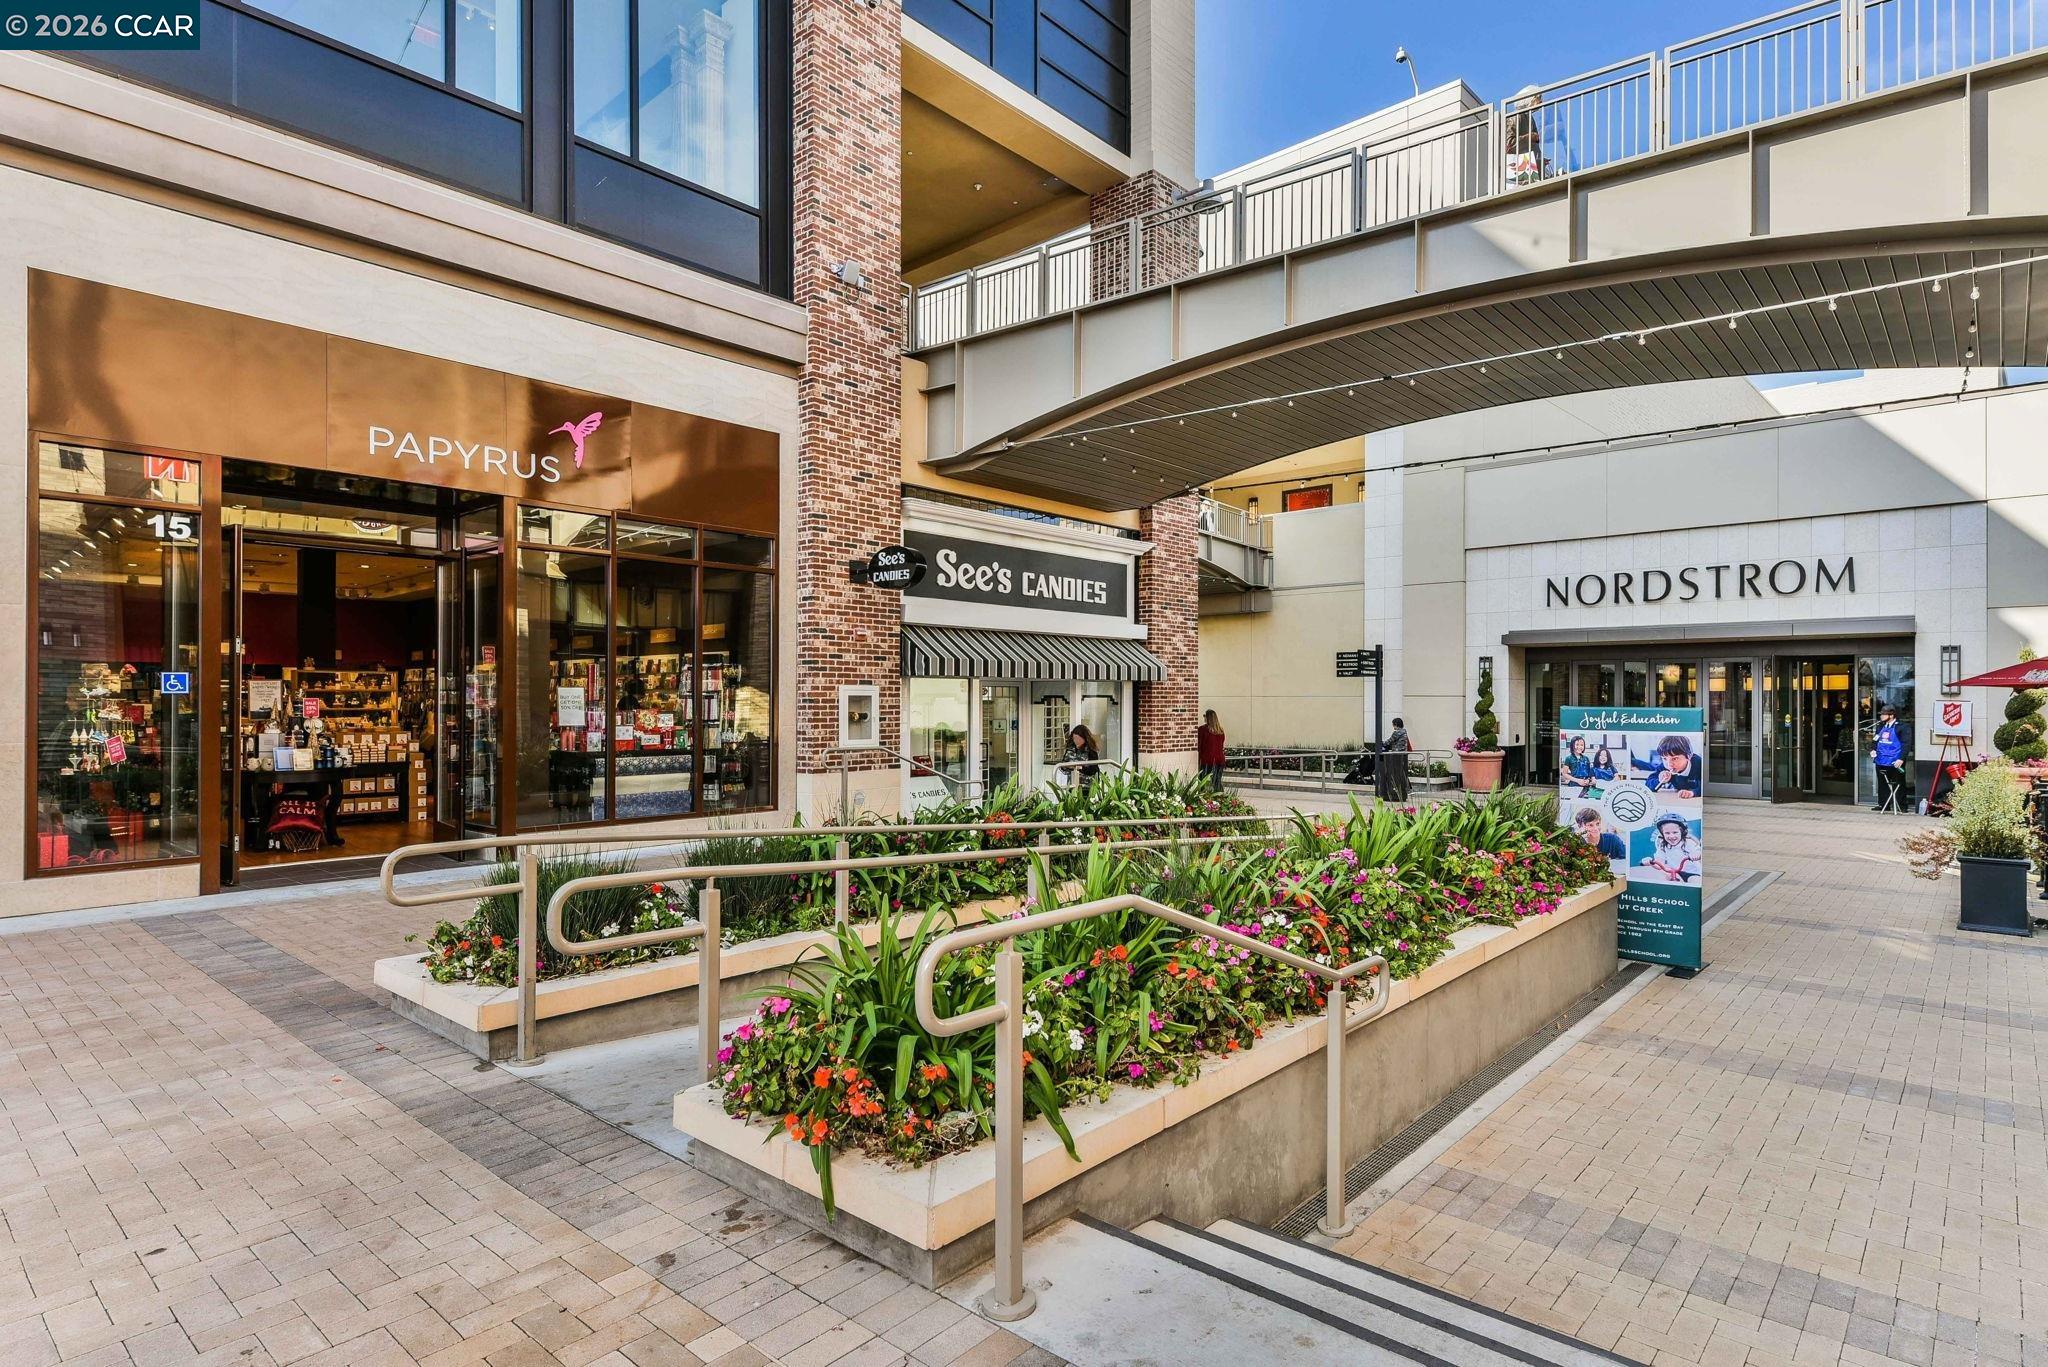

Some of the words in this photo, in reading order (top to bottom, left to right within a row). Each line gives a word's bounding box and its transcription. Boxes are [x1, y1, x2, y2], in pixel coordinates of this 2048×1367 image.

[368, 425, 561, 483] PAPYRUS
[147, 514, 191, 540] 15
[878, 551, 906, 566] See's
[873, 569, 910, 583] CANDIES
[935, 548, 1012, 594] See's
[1021, 571, 1107, 605] CANDIES
[1546, 556, 1856, 607] NORDSTROM
[1580, 711, 1619, 729] Joyful
[1620, 713, 1681, 726] Education
[917, 788, 946, 799] CANDIES
[279, 807, 316, 816] CALM
[1621, 893, 1648, 903] HILLS
[1651, 896, 1690, 907] SCHOOL
[1632, 904, 1664, 915] CREEK
